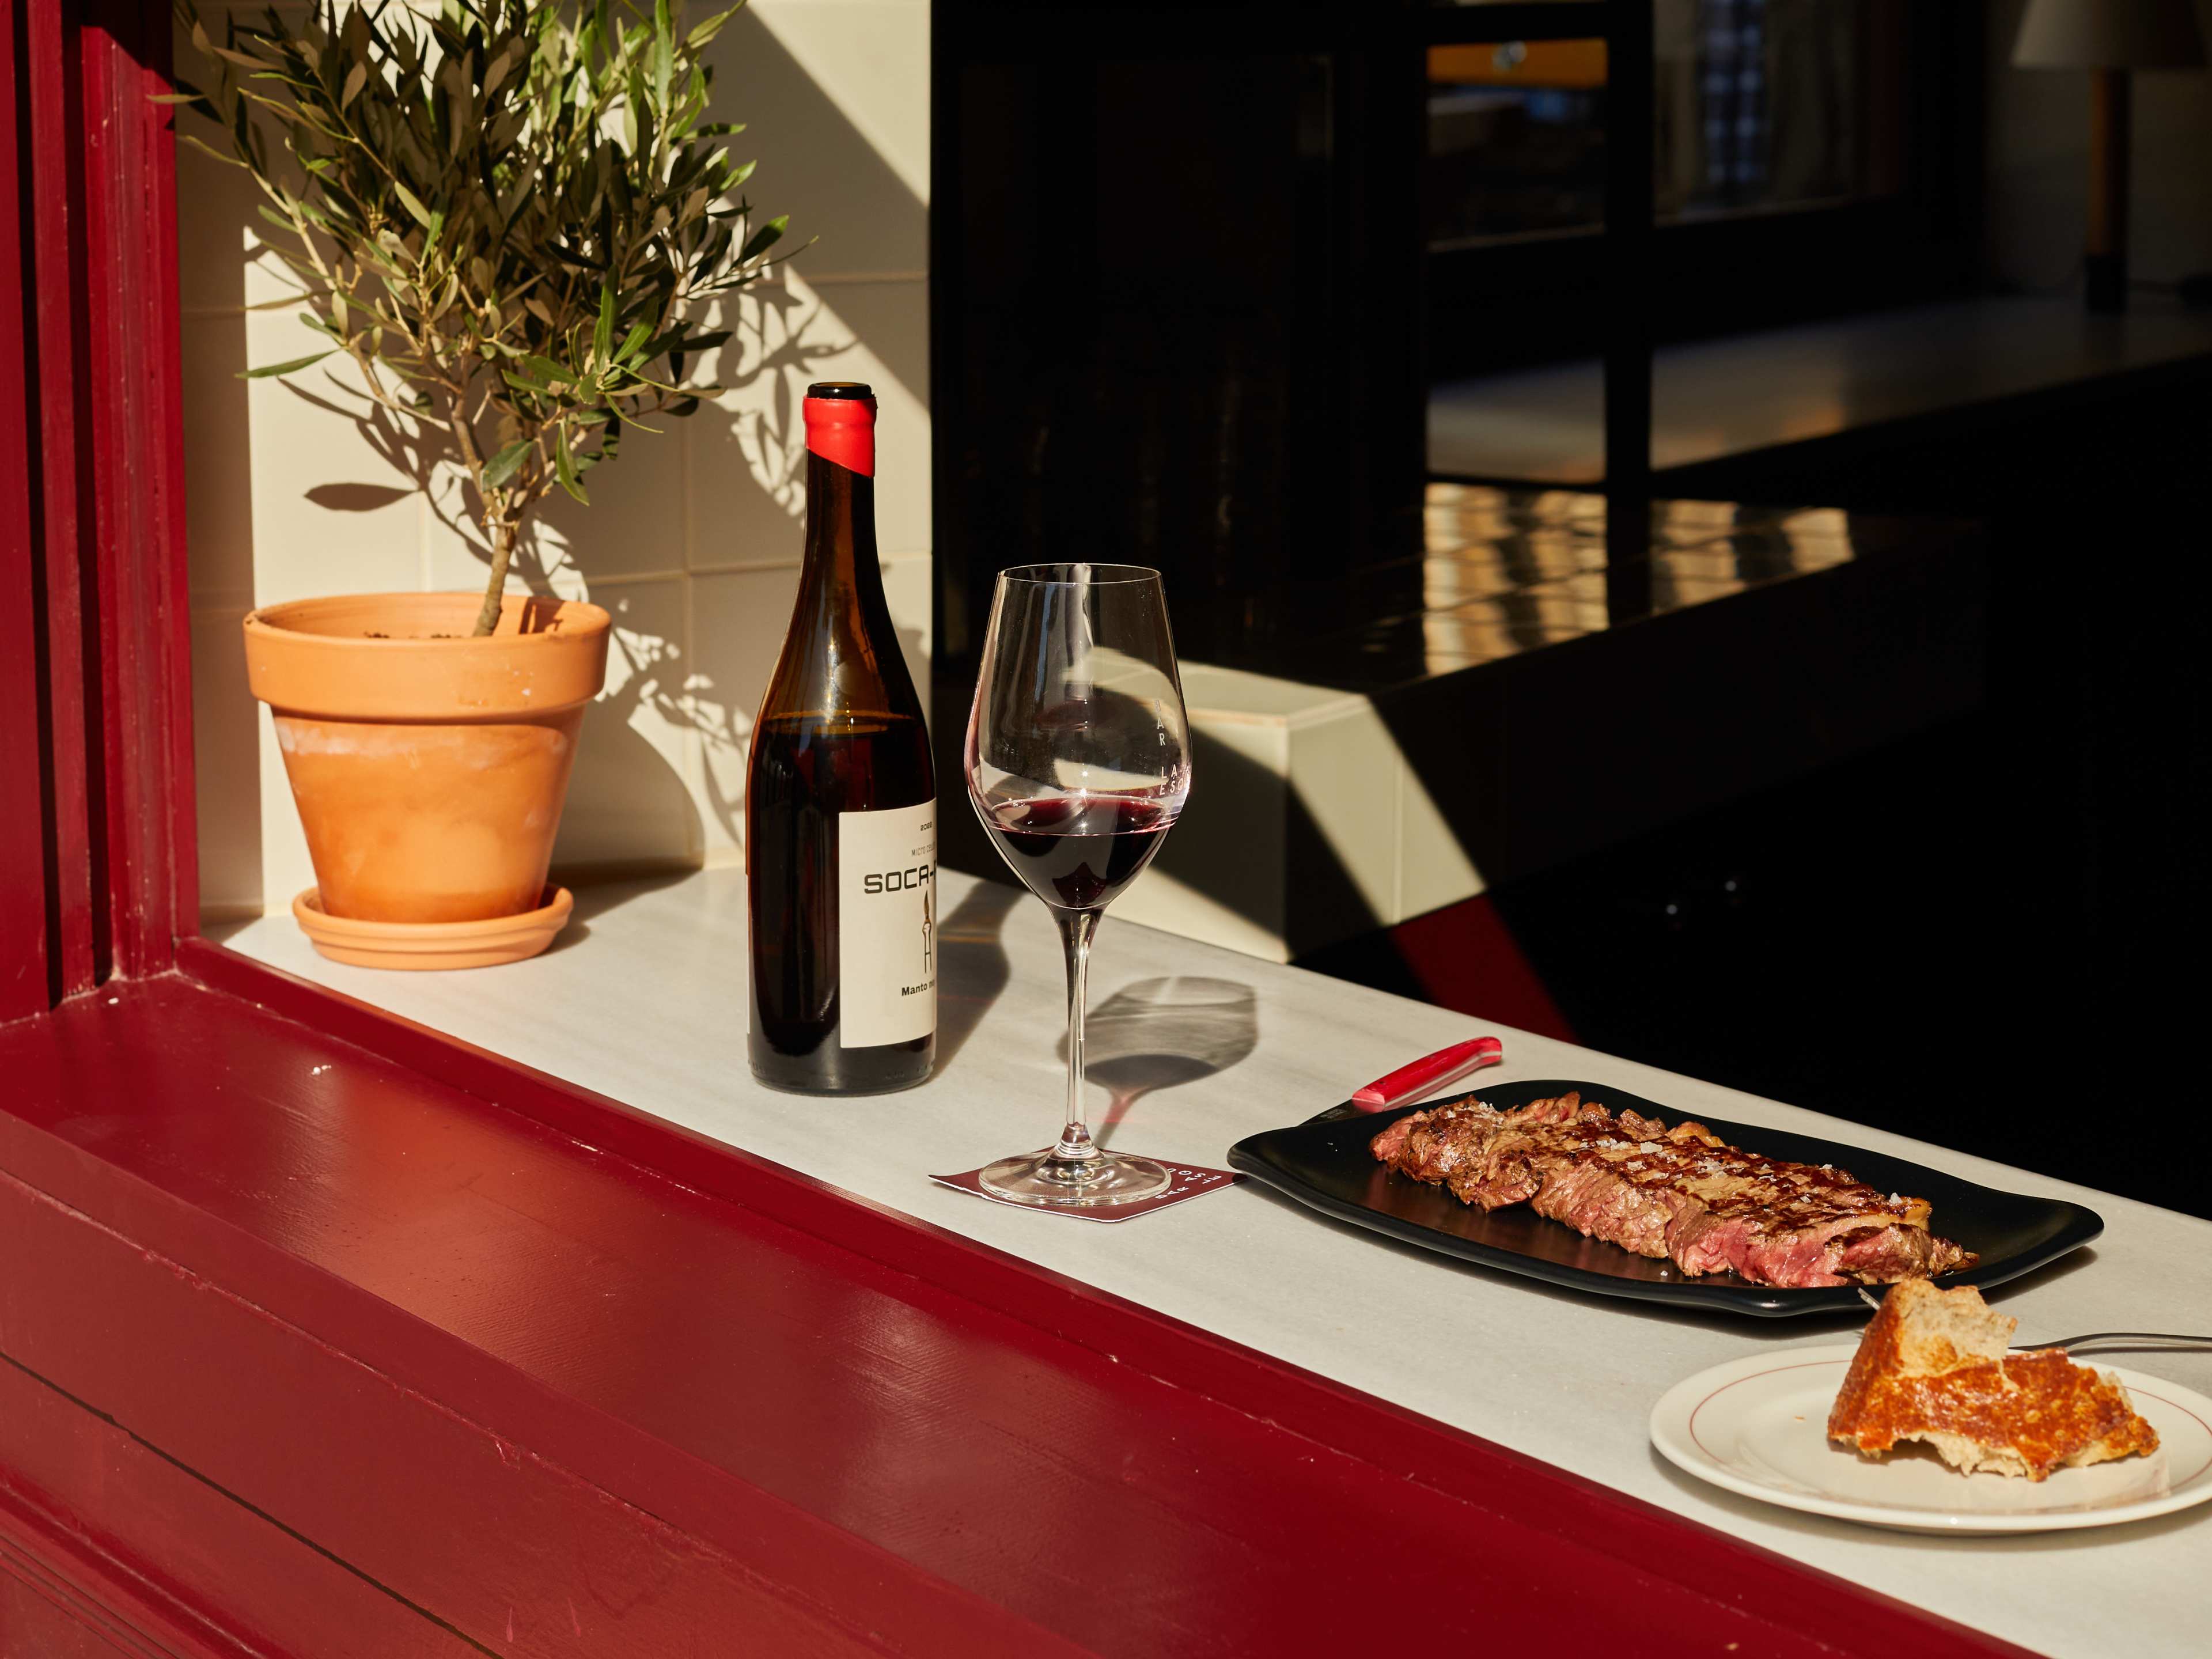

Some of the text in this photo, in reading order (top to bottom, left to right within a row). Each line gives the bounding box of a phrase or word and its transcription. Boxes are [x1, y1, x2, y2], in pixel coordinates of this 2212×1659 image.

[1161, 764, 1177, 779] LA
[902, 983, 927, 997] Manto
[1155, 1186, 1190, 1199] BAR
